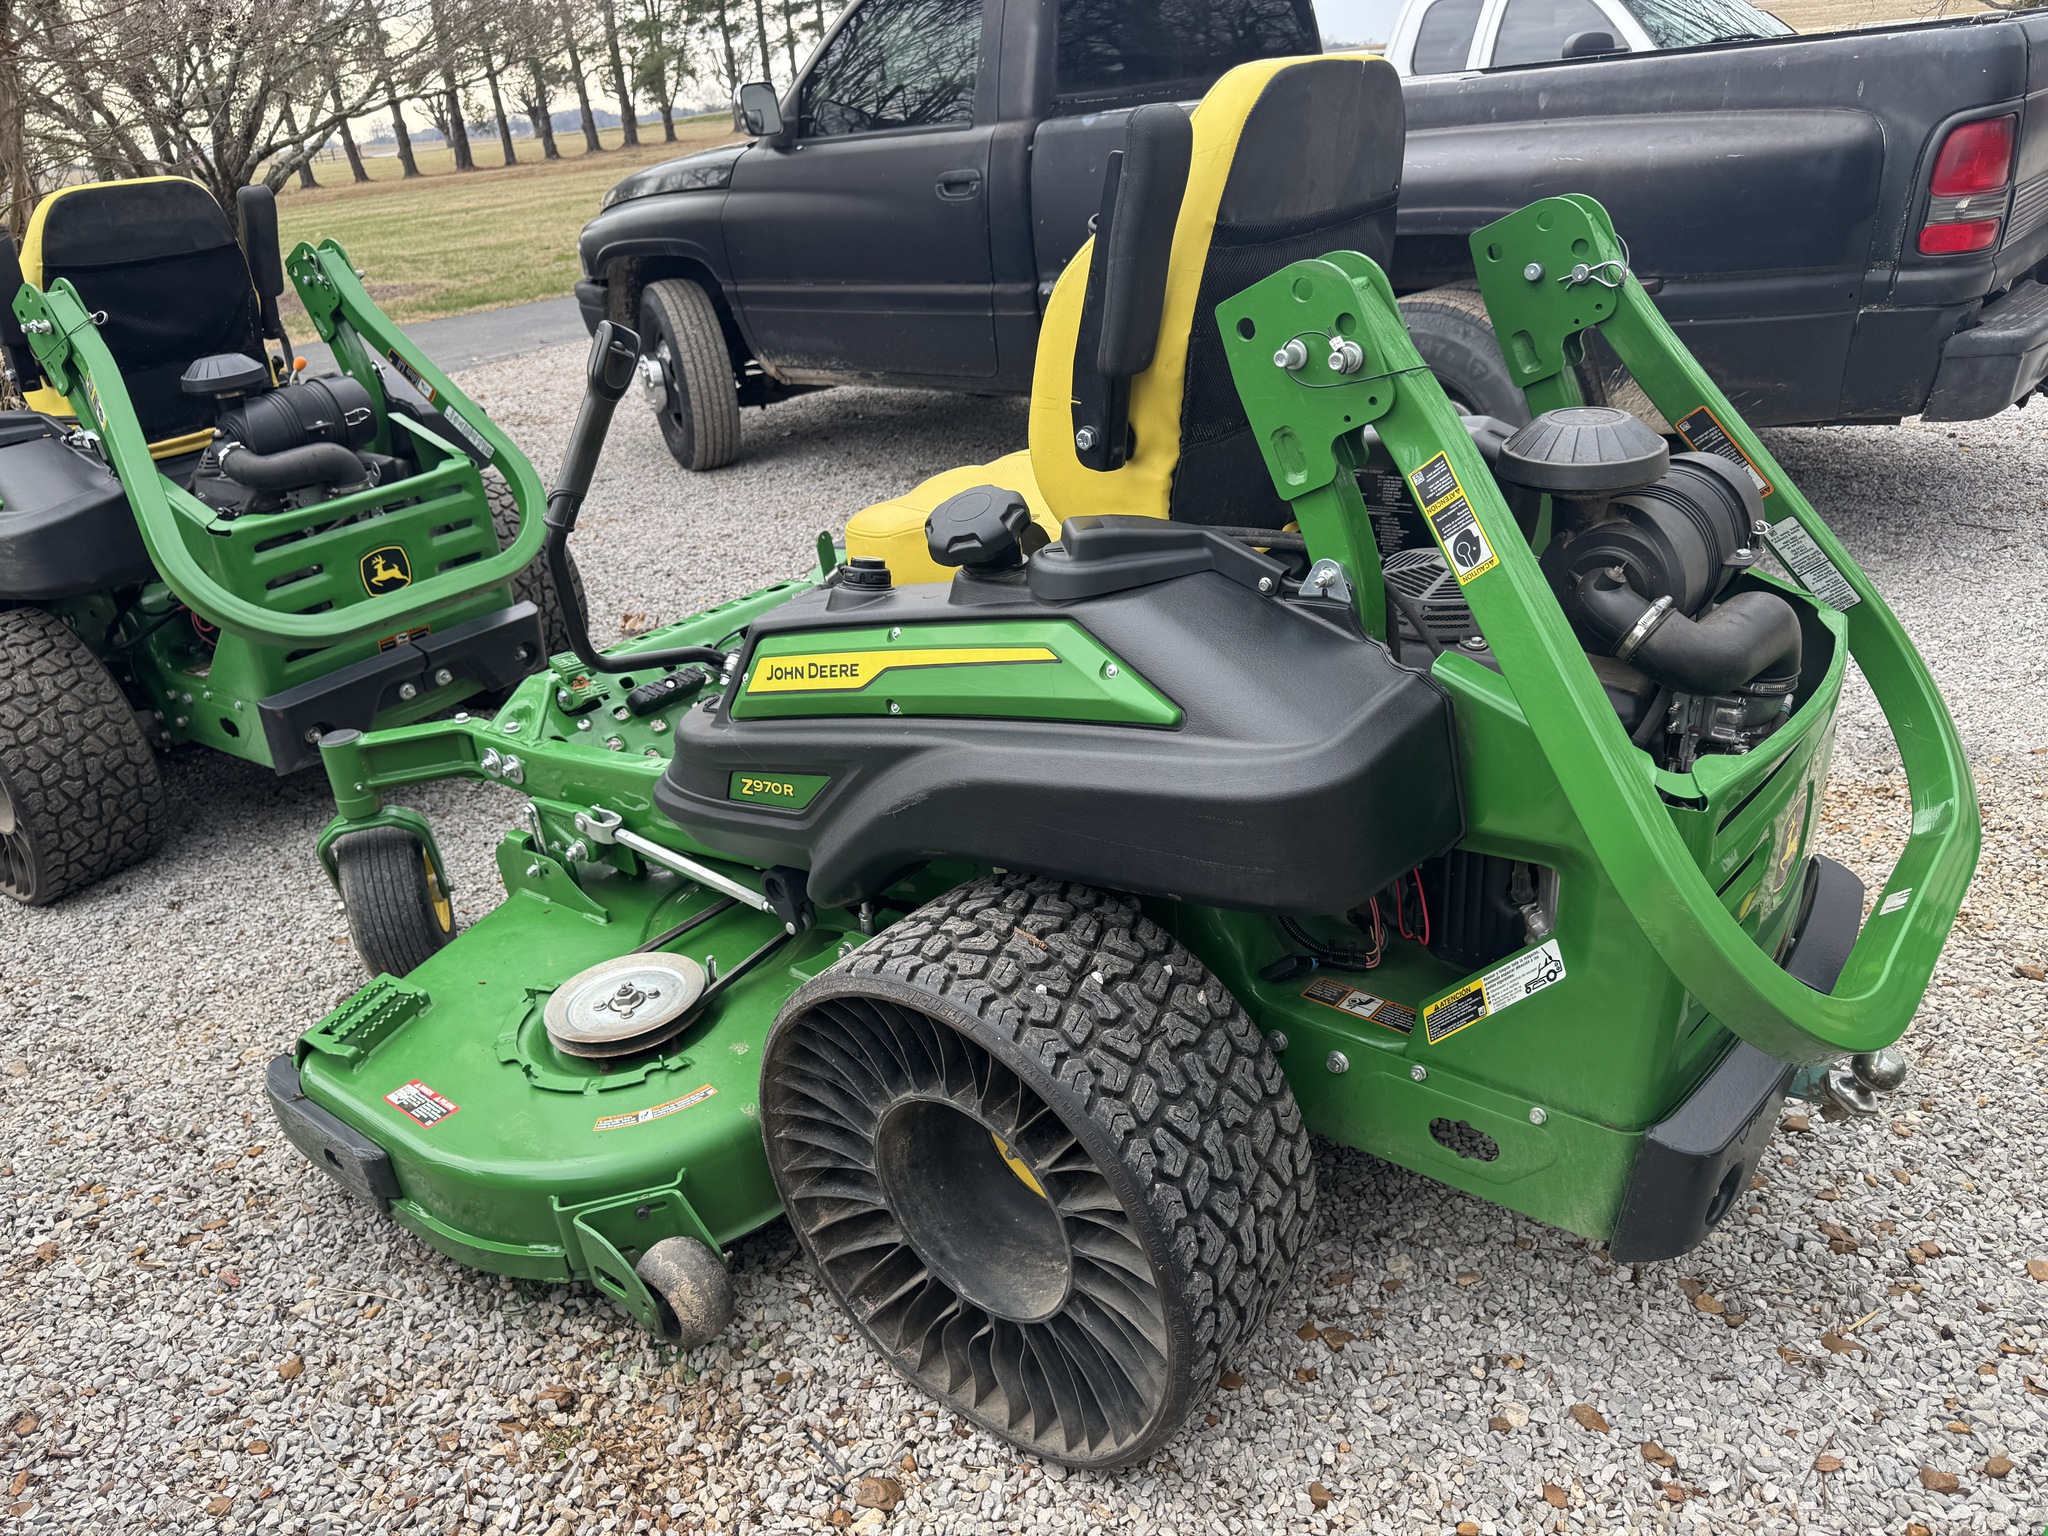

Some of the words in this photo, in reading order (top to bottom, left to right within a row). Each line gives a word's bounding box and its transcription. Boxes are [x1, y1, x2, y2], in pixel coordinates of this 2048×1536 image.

[1462, 563, 1490, 583] CAUTION
[766, 664, 805, 681] JOHN
[807, 662, 860, 679] DEERE
[741, 777, 795, 798] Z970R
[1440, 987, 1471, 1008] ATENCIÓN
[902, 989, 979, 1031] MICHELIN
[1085, 1131, 1104, 1159] NOT
[1104, 1156, 1122, 1180] FOR
